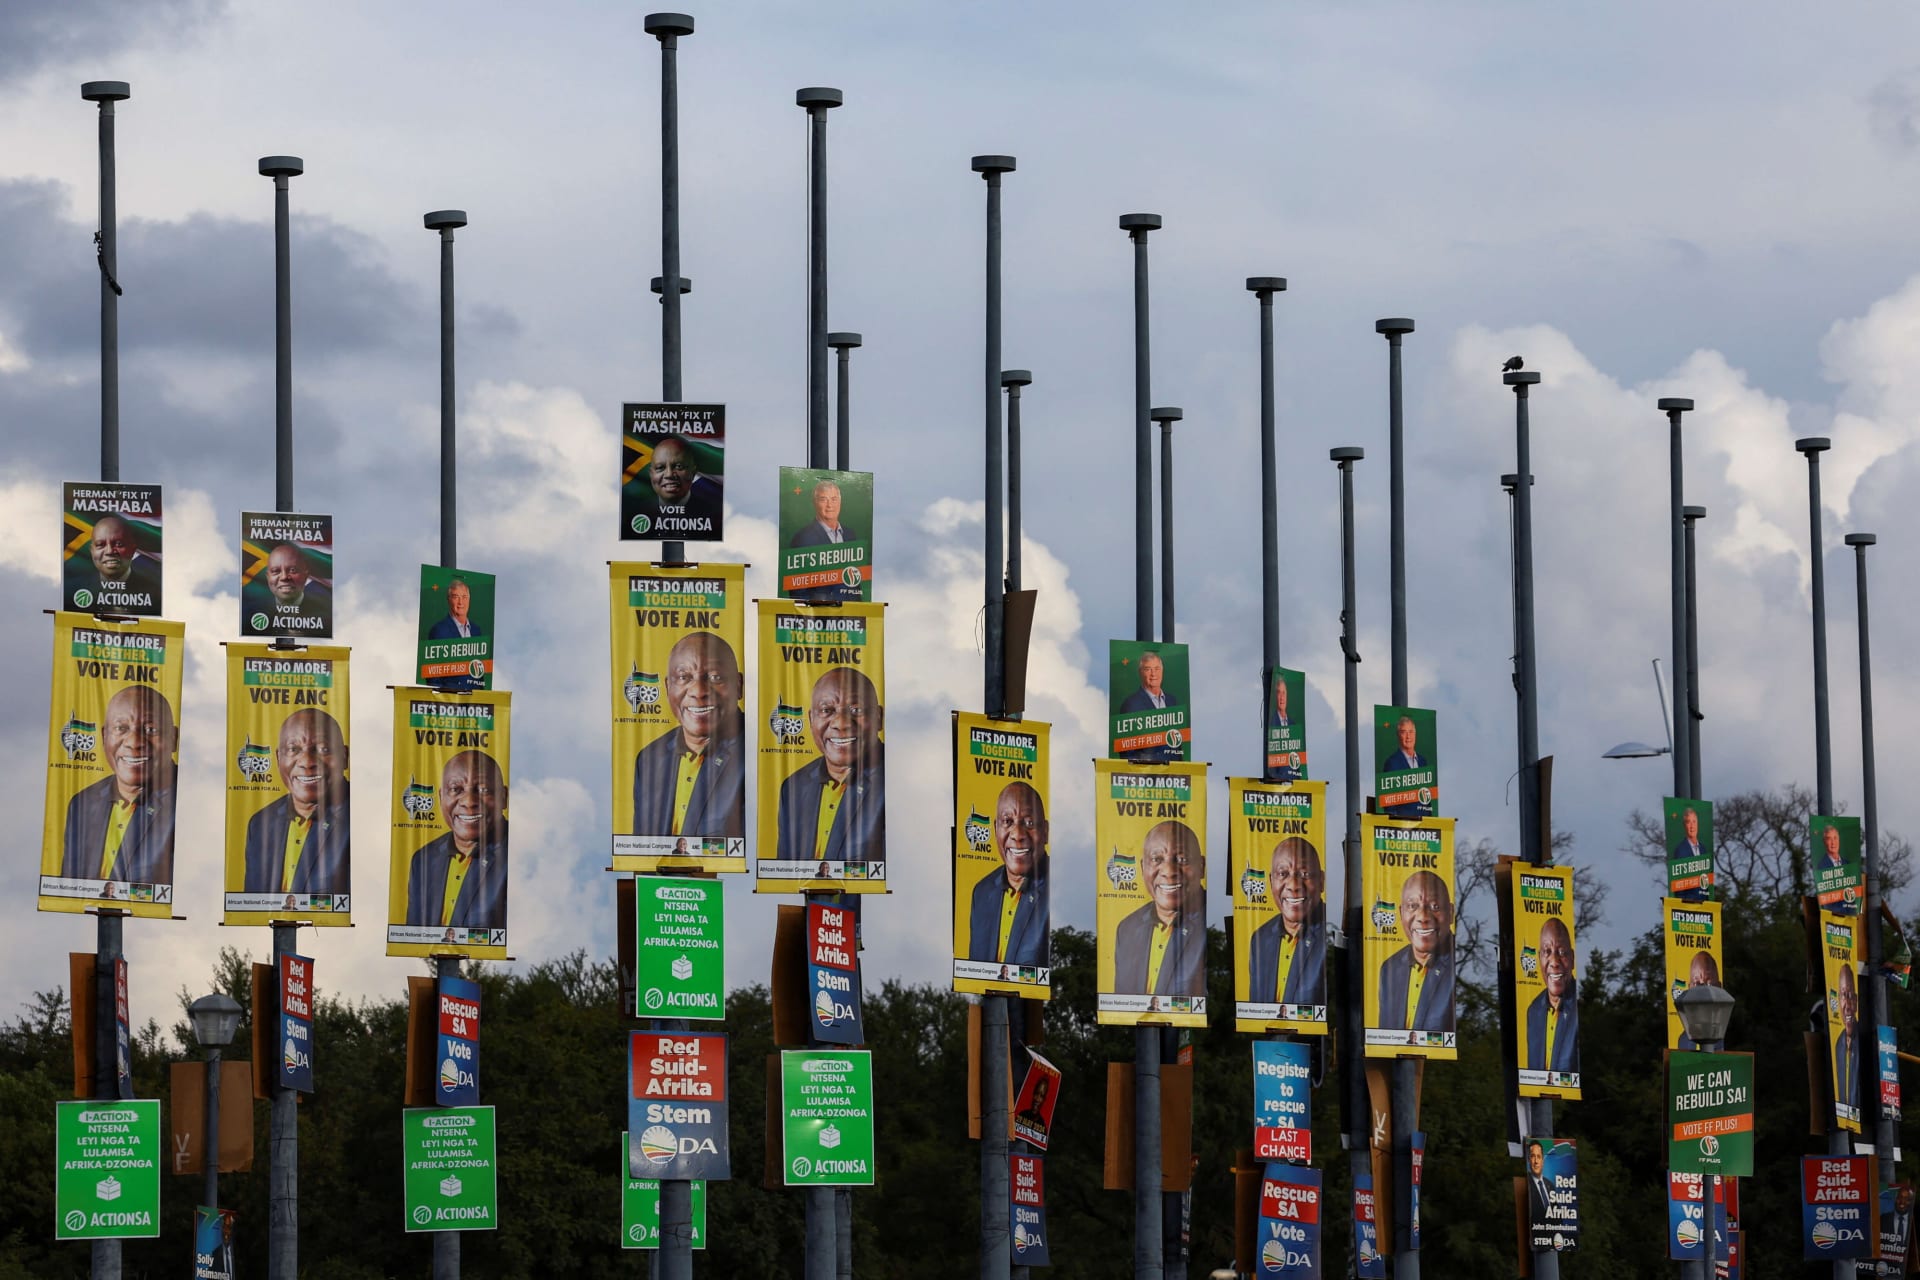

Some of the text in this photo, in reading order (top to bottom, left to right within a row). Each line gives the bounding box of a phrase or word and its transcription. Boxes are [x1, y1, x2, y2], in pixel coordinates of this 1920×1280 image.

[633, 410, 678, 419] HERMAN
[632, 421, 715, 434] MASHABA
[73, 489, 116, 499] HERMAN
[72, 500, 152, 513] MASHABA
[660, 506, 685, 514] VOTE
[250, 519, 290, 528] HERMAN
[654, 517, 712, 532] ACTIONSA
[250, 528, 324, 542] MASHABA
[787, 547, 864, 570] LET'S REBUILD
[101, 581, 126, 590] VOTE
[631, 579, 723, 596] LET'S DO MORE,
[792, 577, 808, 587] VOTE
[810, 576, 819, 586] FF
[97, 593, 152, 606] ACTIONSA
[644, 593, 710, 607] TOGETHER.
[276, 605, 300, 614] VOTE
[272, 616, 323, 630] ACTIONSA
[636, 610, 720, 628] VOTE ANC
[74, 631, 164, 652] LET'S DO MORE,
[88, 645, 150, 661] TOGETHER.
[77, 661, 158, 683] VOTE ANC
[412, 704, 492, 720] LET'S DO MORE,
[638, 704, 662, 714] ANC
[424, 716, 480, 729] TOGETHER.
[1117, 712, 1184, 733] LET'S REBUILD
[416, 730, 488, 748] VOTE ANC
[972, 731, 1035, 750] LET'S DO MORE,
[1122, 738, 1137, 748] VOTE
[1138, 737, 1145, 746] FF
[980, 743, 1026, 759] TOGETHER.
[974, 758, 1032, 780] VOTE ANC
[1376, 828, 1440, 843] LET'S DO MORE,
[1385, 840, 1430, 851] TOGETHER.
[1379, 853, 1437, 868] VOTE ANC
[661, 889, 701, 900] I-ACTION
[664, 902, 698, 911] NTSENA
[654, 913, 708, 924] LEYI NGA TA
[822, 909, 843, 927] Red
[660, 926, 703, 936] LULAMISA
[818, 928, 846, 946] Suid-
[644, 937, 719, 949] AFRIKA-DZONGA
[816, 946, 850, 966] Afrika
[817, 970, 850, 992] Stem
[666, 992, 718, 1008] ACTIONSA
[442, 997, 478, 1020] Rescue
[834, 1003, 855, 1022] DA
[452, 1018, 468, 1036] SA
[448, 1040, 472, 1060] Vote
[658, 1038, 700, 1056] Red
[650, 1058, 707, 1076] Suid-
[1258, 1060, 1310, 1079] Register
[458, 1070, 474, 1087] DA
[810, 1074, 846, 1082] NTSENA
[1688, 1070, 1732, 1091] WE CAN
[646, 1078, 712, 1096] Afrika
[800, 1085, 856, 1094] LEYI NGA TA
[1280, 1082, 1294, 1096] to
[806, 1096, 851, 1106] LULAMISA
[1264, 1098, 1306, 1114] rescue
[1676, 1086, 1746, 1112] REBUILD SA!
[85, 1112, 132, 1122] I-ACTION
[646, 1104, 710, 1124] Stem
[790, 1108, 867, 1118] AFRIKA-DZONGA
[88, 1124, 130, 1133] NTSENA
[1278, 1116, 1295, 1128] SA
[1683, 1122, 1702, 1136] VOTE
[1704, 1121, 1714, 1133] FF
[77, 1136, 140, 1146] LEYI NGA TA
[1270, 1129, 1298, 1143] LAST
[83, 1148, 134, 1157] LULAMISA
[678, 1138, 718, 1154] DA
[1260, 1144, 1306, 1159] CHANCE
[64, 1160, 153, 1170] AFRIKA-DZONGA
[814, 1159, 867, 1174] ACTIONSA
[1018, 1158, 1034, 1172] Red
[1822, 1160, 1850, 1174] Red
[1016, 1174, 1036, 1187] Suid-
[1556, 1175, 1576, 1188] Red
[1817, 1174, 1856, 1187] Suid-
[1016, 1188, 1038, 1202] Afrika
[1264, 1181, 1317, 1204] Rescue
[1550, 1190, 1576, 1204] Suid-
[1814, 1188, 1860, 1200] Afrika
[1016, 1208, 1039, 1224] Stem
[1278, 1201, 1300, 1219] SA
[1545, 1205, 1577, 1220] Afrika
[1816, 1206, 1860, 1221] Stem
[90, 1211, 151, 1227] ACTIONSA
[1270, 1222, 1306, 1242] Vote
[1838, 1228, 1864, 1241] DA
[1027, 1233, 1042, 1246] DA
[197, 1254, 214, 1266] Solly
[1286, 1252, 1312, 1268] DA
